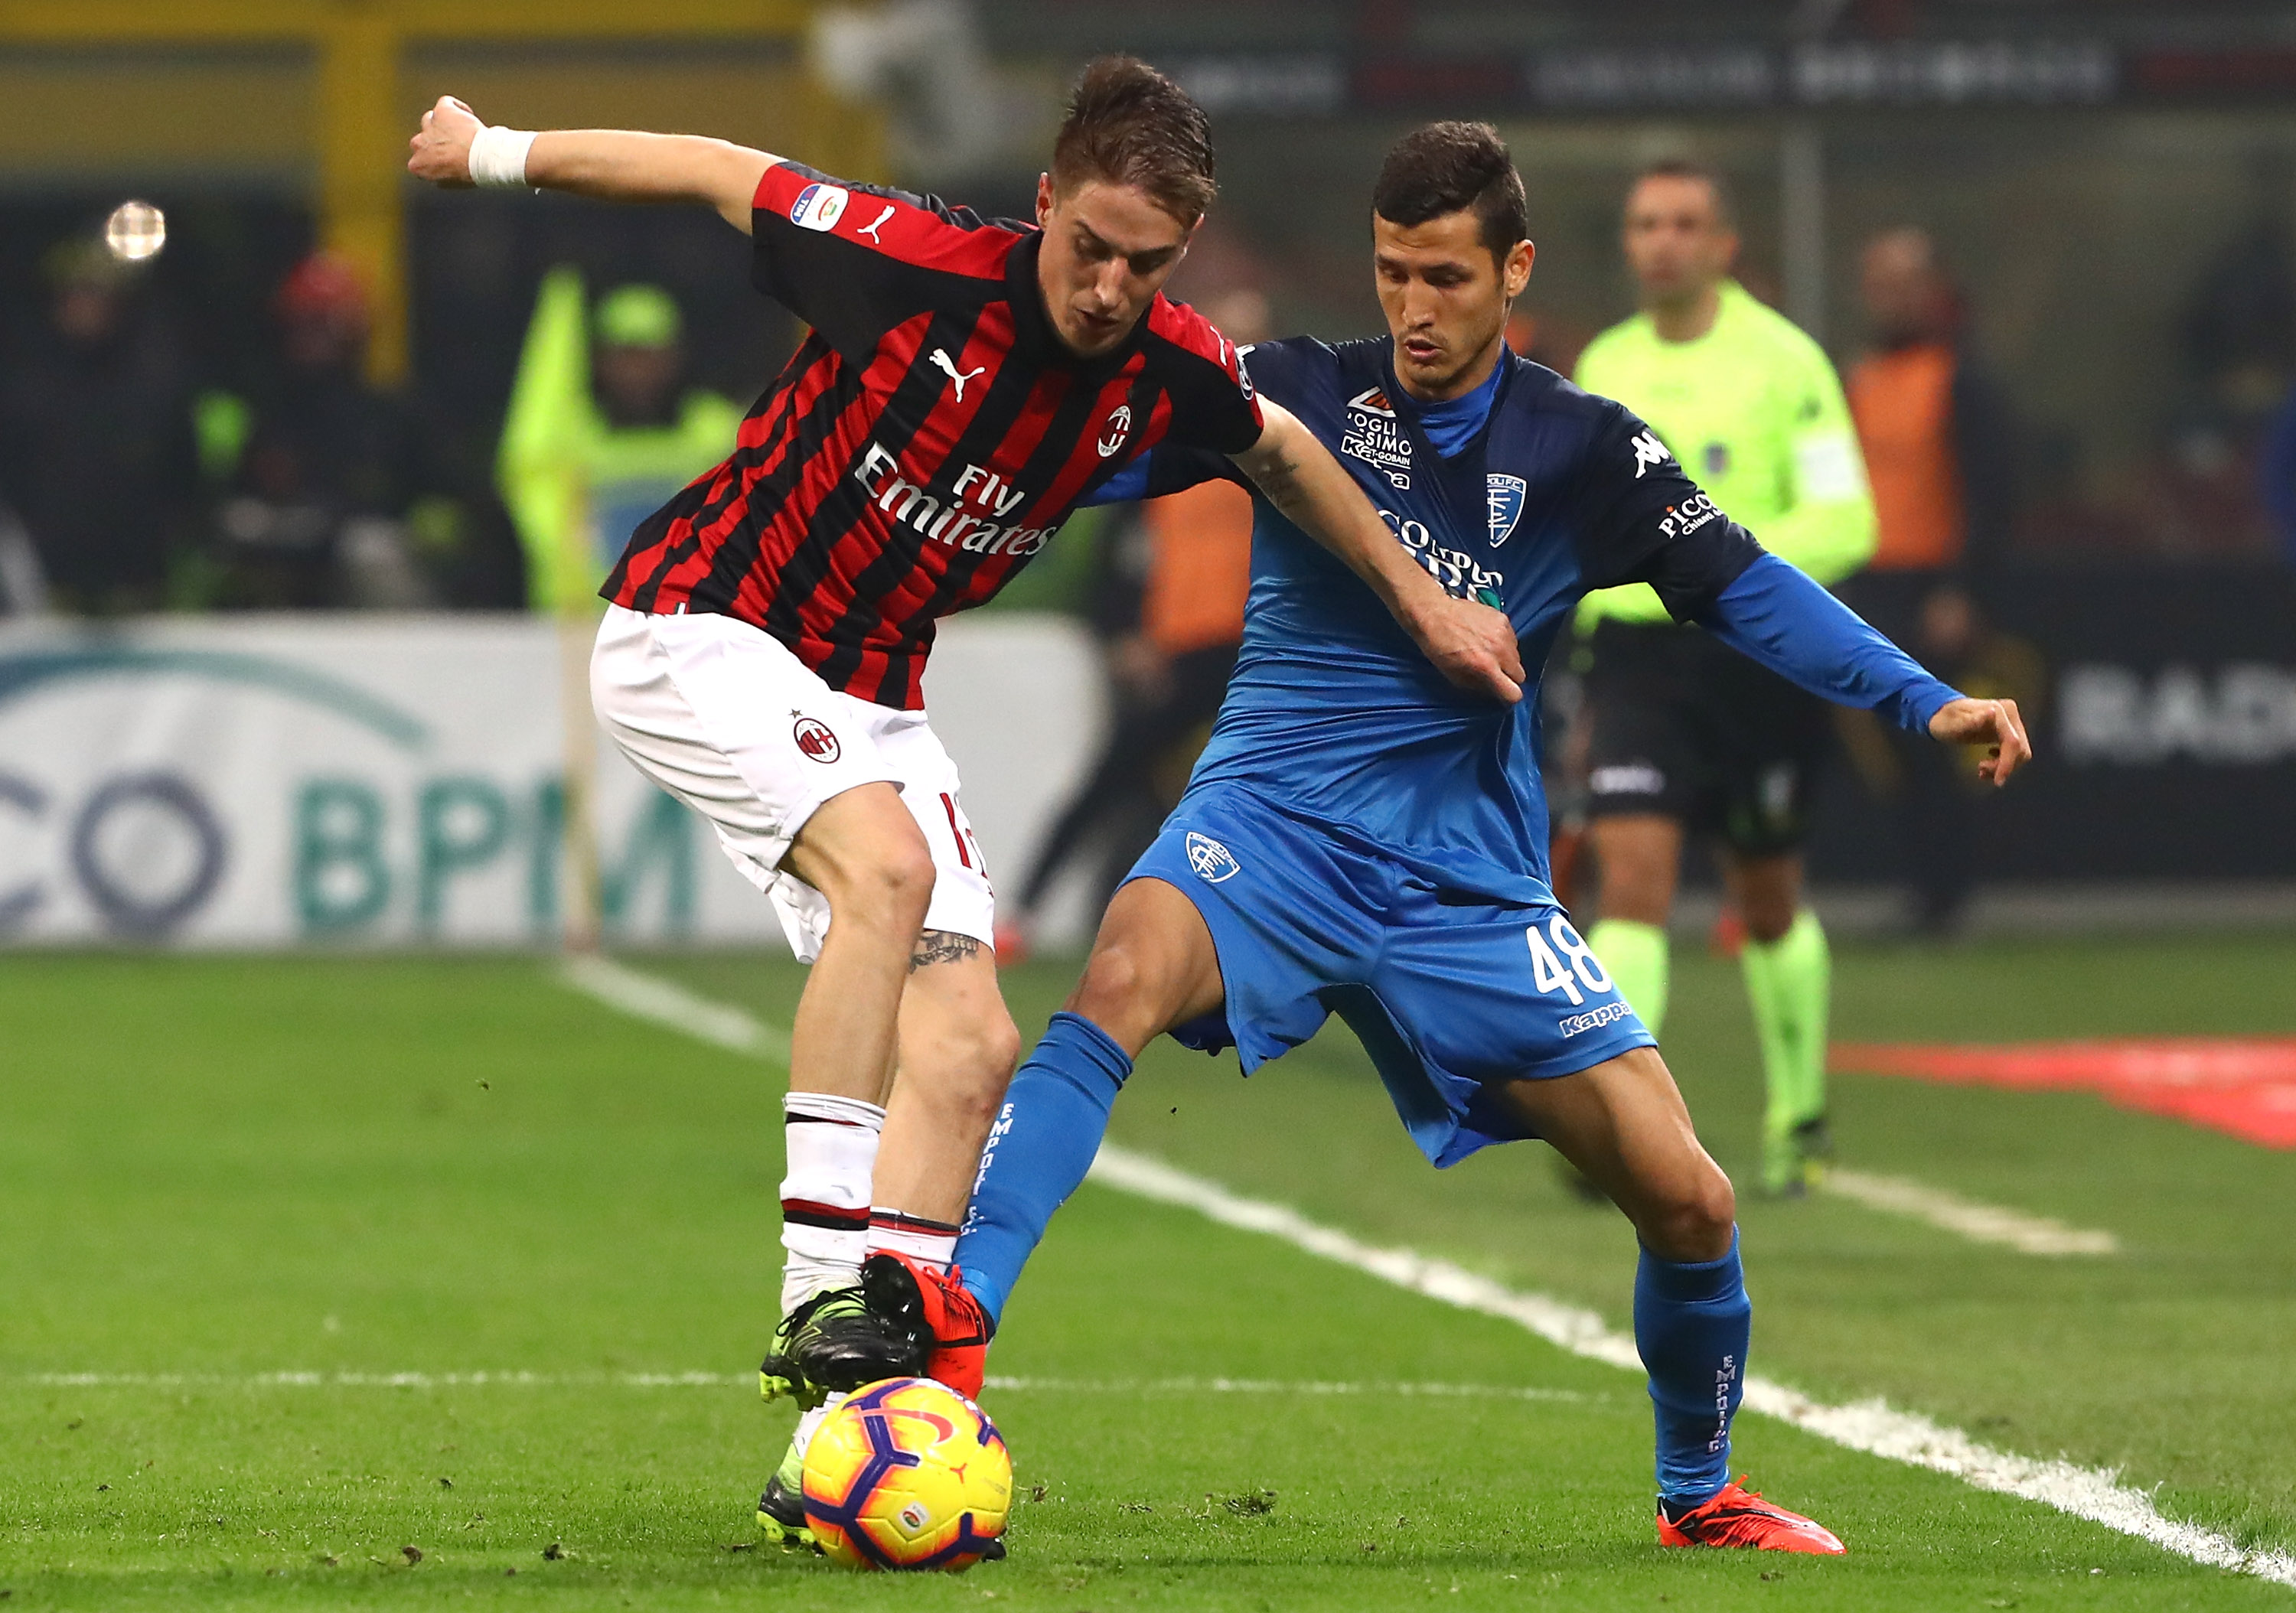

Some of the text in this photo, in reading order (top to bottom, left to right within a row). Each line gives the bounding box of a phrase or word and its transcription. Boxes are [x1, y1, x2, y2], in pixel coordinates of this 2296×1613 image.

[854, 441, 1057, 556] Emirates
[952, 463, 1026, 517] Fly
[295, 773, 698, 935] BPM
[1525, 915, 1613, 1006] 48
[1559, 1001, 1633, 1038] Kappa
